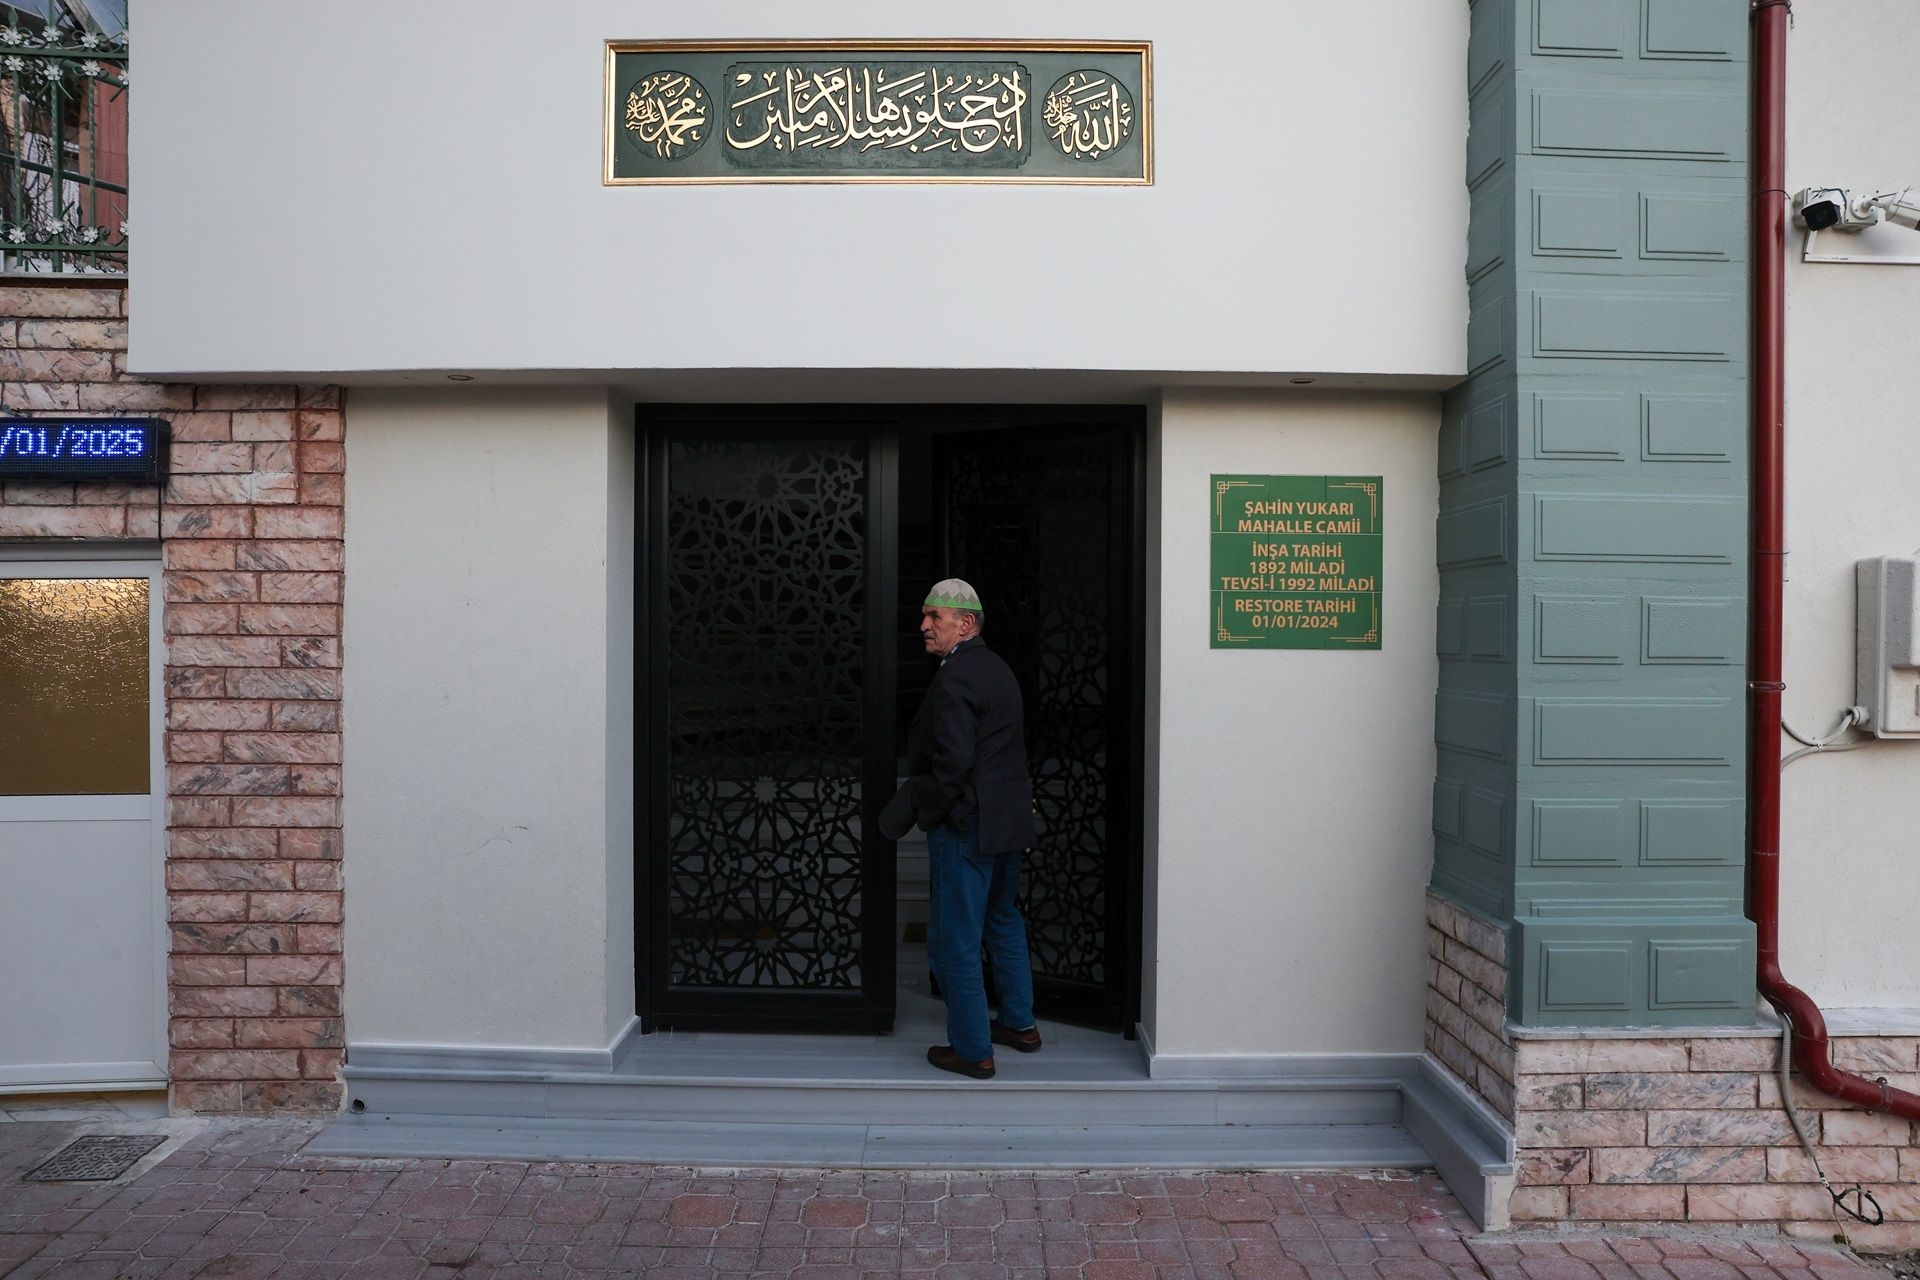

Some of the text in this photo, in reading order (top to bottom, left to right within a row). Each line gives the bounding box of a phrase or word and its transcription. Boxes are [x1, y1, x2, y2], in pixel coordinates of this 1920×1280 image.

[1245, 499, 1353, 517] ŞAHİN YUKARI
[1239, 518, 1361, 534] MAHALLE CAMİİ
[1253, 541, 1342, 560] İNŞA TARİHİ
[1250, 559, 1345, 574] 1892 MİLADİ
[1221, 575, 1374, 591] TEVSİ-İ 1992 MİLADİ
[1235, 598, 1356, 613] RESTORE TARİHİ
[1252, 615, 1338, 628] 01/01/2024
